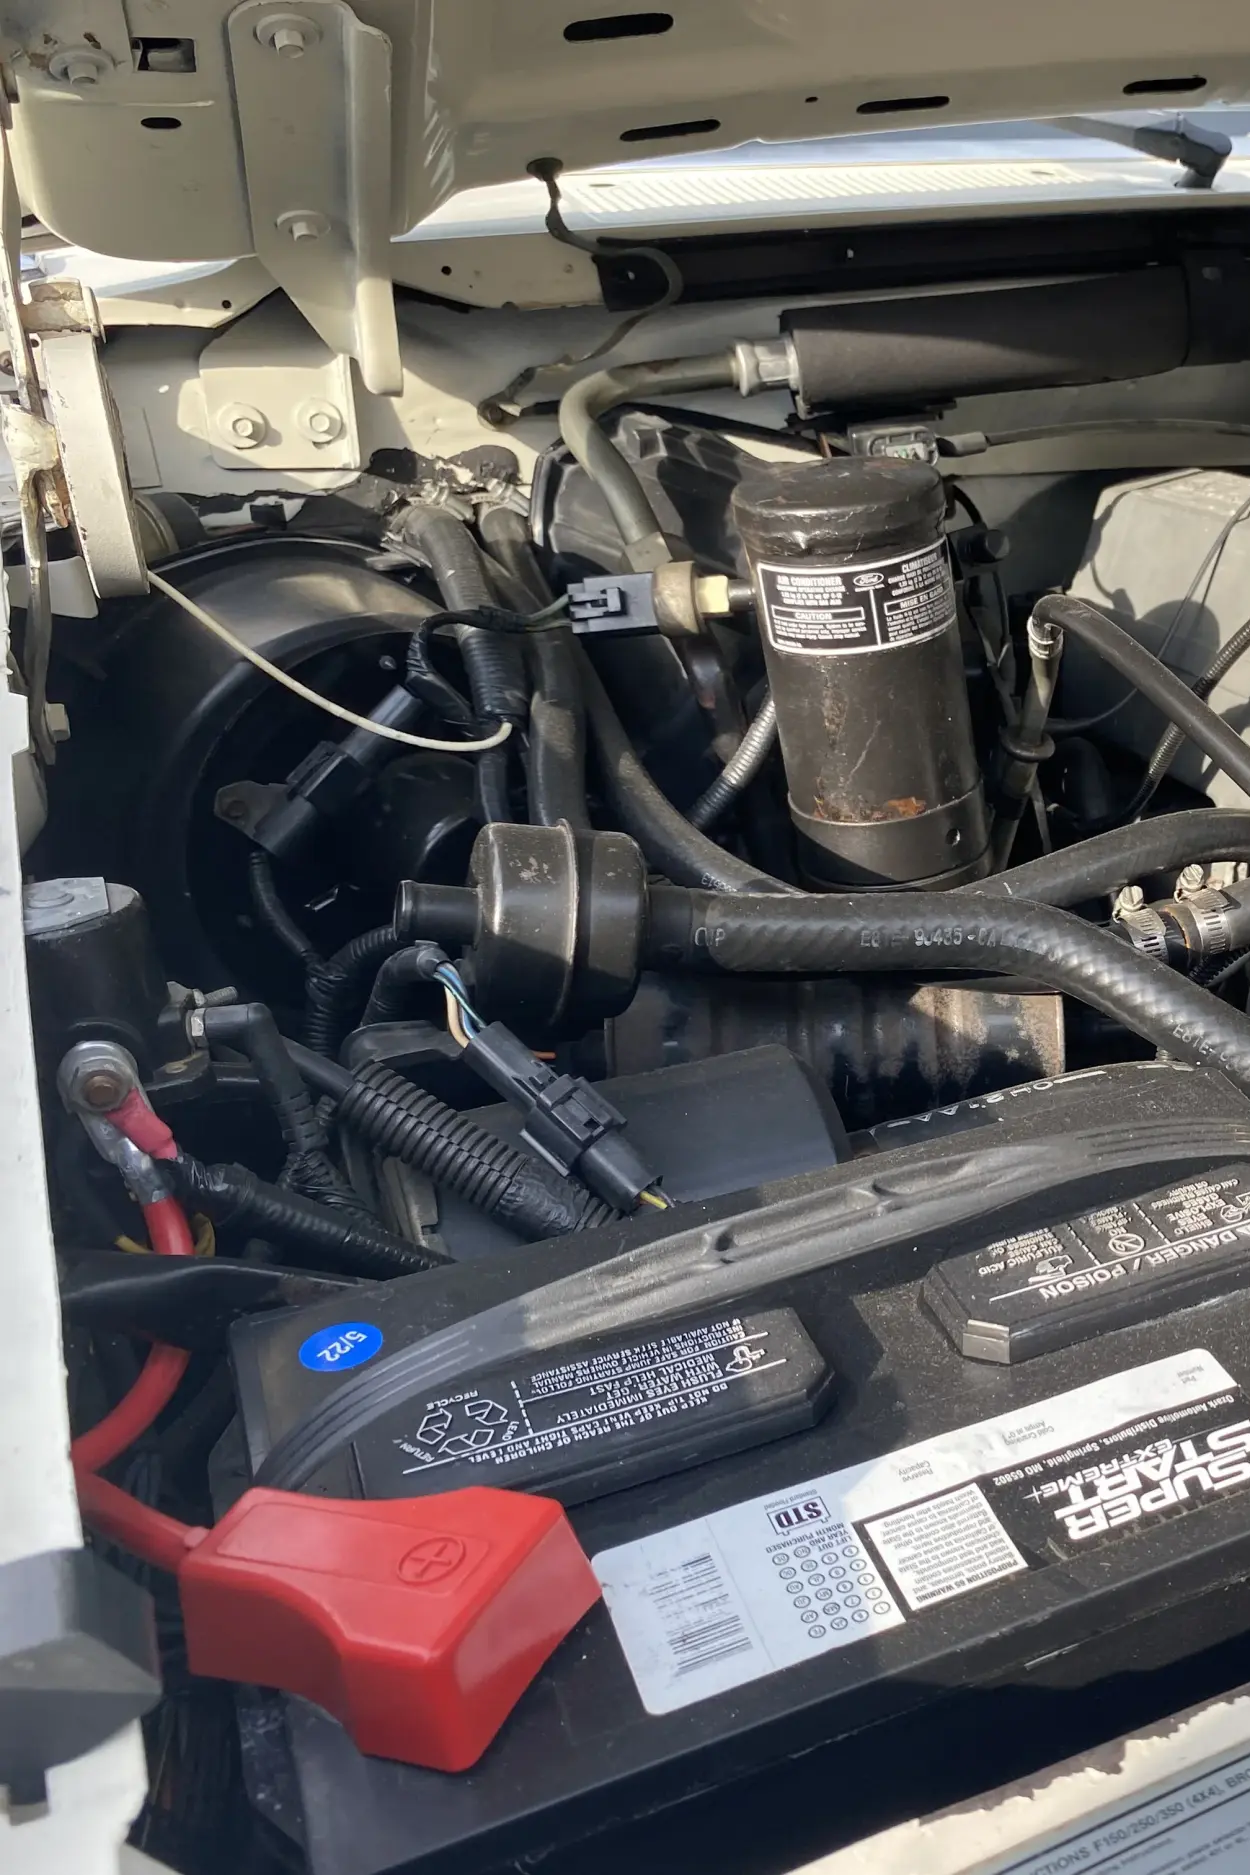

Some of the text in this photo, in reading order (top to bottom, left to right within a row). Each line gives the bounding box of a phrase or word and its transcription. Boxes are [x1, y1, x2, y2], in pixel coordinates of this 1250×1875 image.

[900, 598, 919, 610] MISE
[795, 612, 833, 621] CAUTION
[1166, 1197, 1225, 1222] EXPLOSIVE
[1182, 1192, 1218, 1208] GASES
[1173, 1218, 1213, 1236] SHIELD
[1177, 1212, 1207, 1226] EYES
[1107, 1225, 1126, 1236] NO
[977, 1243, 1064, 1276] SULFURIC ACID
[1037, 1228, 1237, 1299] DANGER POISON
[316, 1331, 368, 1362] 5/22
[678, 1343, 699, 1355] FOR
[702, 1330, 745, 1348] CAUTION
[530, 1320, 729, 1382] NOT AVAILABLE SEEK SERVICE ASSISTANCE
[532, 1324, 742, 1388] INSTRUCTIONS IN VEHICLE OWNERS MANUAL
[653, 1349, 678, 1362] SAFE
[574, 1364, 622, 1384] STARTING
[588, 1352, 714, 1395] MEDICAL HELP FAST
[623, 1357, 652, 1371] JUMP
[684, 1360, 719, 1377] WITH
[427, 1390, 478, 1411] RECYCLE
[555, 1368, 723, 1423] FLUSH EYES IMMEDIATELY
[604, 1386, 630, 1400] GET
[467, 1382, 728, 1463] DO NOT TIP KEEP VENT CAPS TIGHT AND LEVEL
[493, 1395, 708, 1464] KEEP OUT OF THE REACH OF CHILDREN
[501, 1421, 520, 1441] LEAD
[991, 1393, 1235, 1486] Ozark Automotive Distributors, Springfield, MO 65802
[1003, 1425, 1055, 1447] Cold Cranking
[399, 1442, 435, 1463] RETURN
[897, 1459, 930, 1476] Capacity
[901, 1467, 933, 1483] Reserve
[763, 1488, 817, 1511] Standard Flooded
[772, 1500, 822, 1530] STD
[765, 1521, 844, 1553] MONTH PURCHASED
[808, 1528, 848, 1547] YEAR AND
[817, 1534, 851, 1551] LIFT OUT
[915, 1559, 1019, 1602] PROPOSITION 65 WARNING
[1093, 1803, 1185, 1852] F150/250/350
